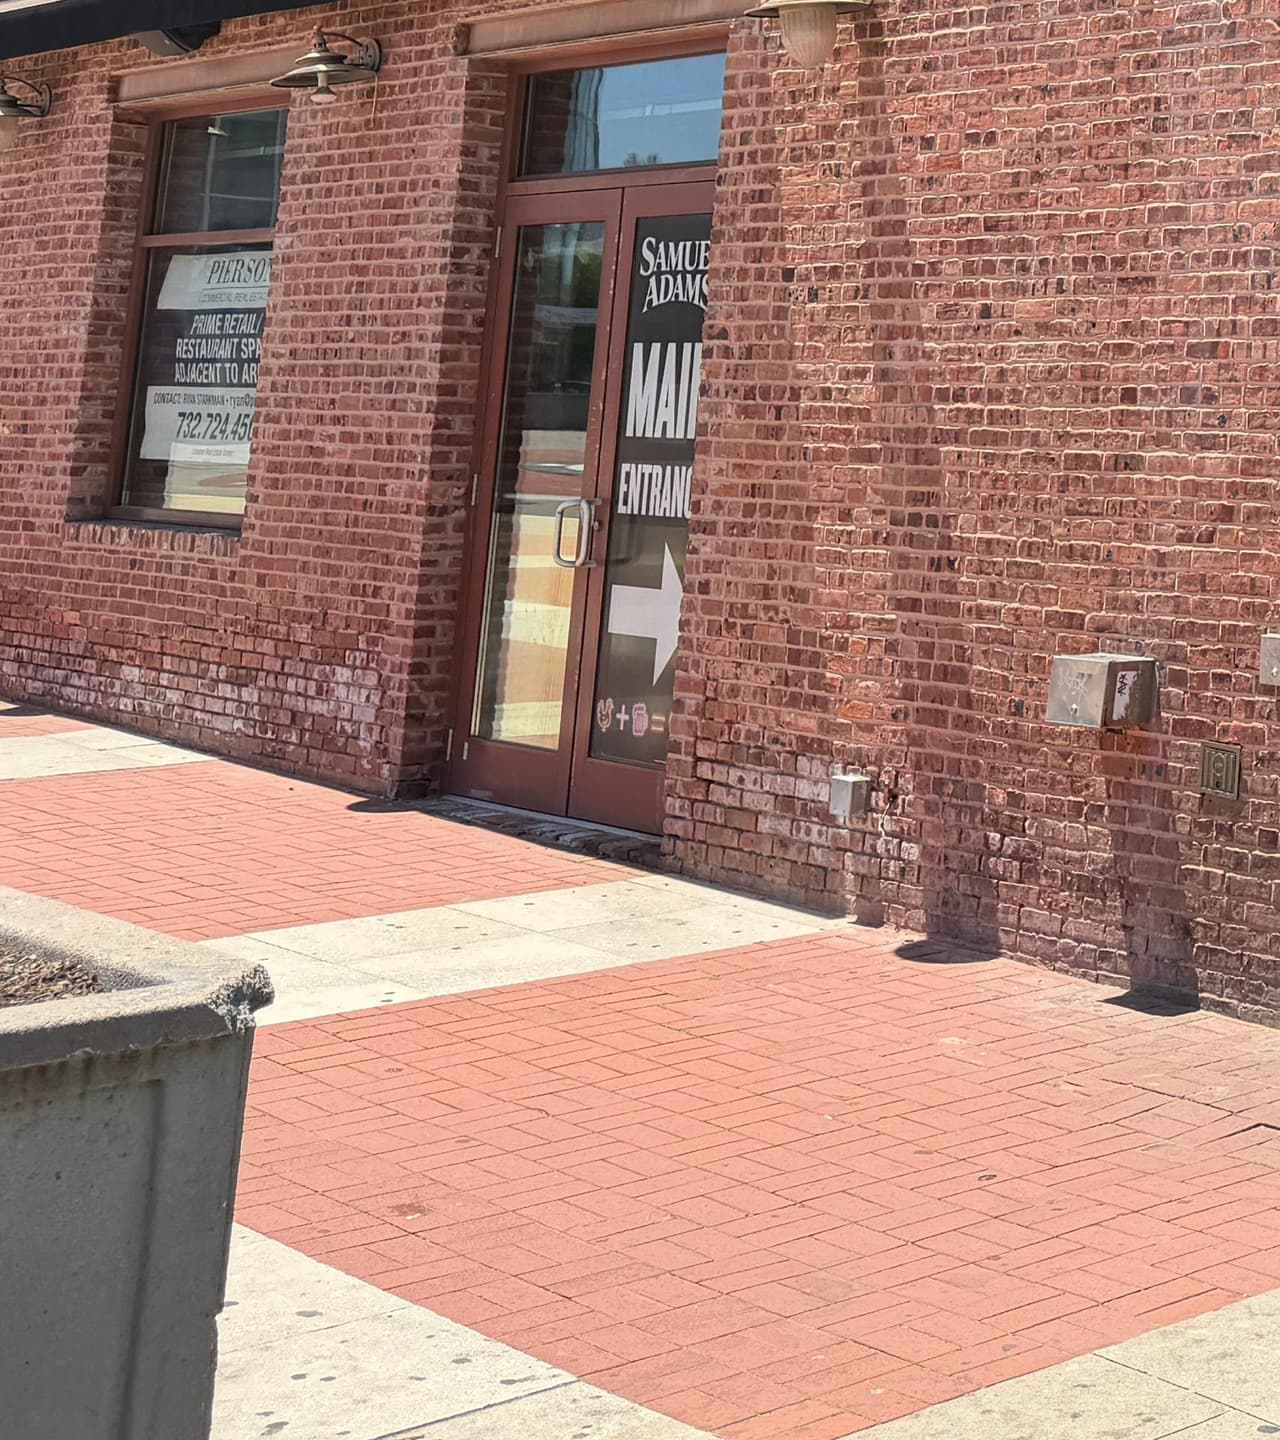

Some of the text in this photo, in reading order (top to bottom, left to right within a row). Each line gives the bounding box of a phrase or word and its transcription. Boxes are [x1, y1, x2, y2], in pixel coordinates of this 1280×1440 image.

[190, 314, 222, 335] PRIME
[176, 338, 239, 359] RESTAURANT
[174, 363, 259, 384] ADJACENT TO AR
